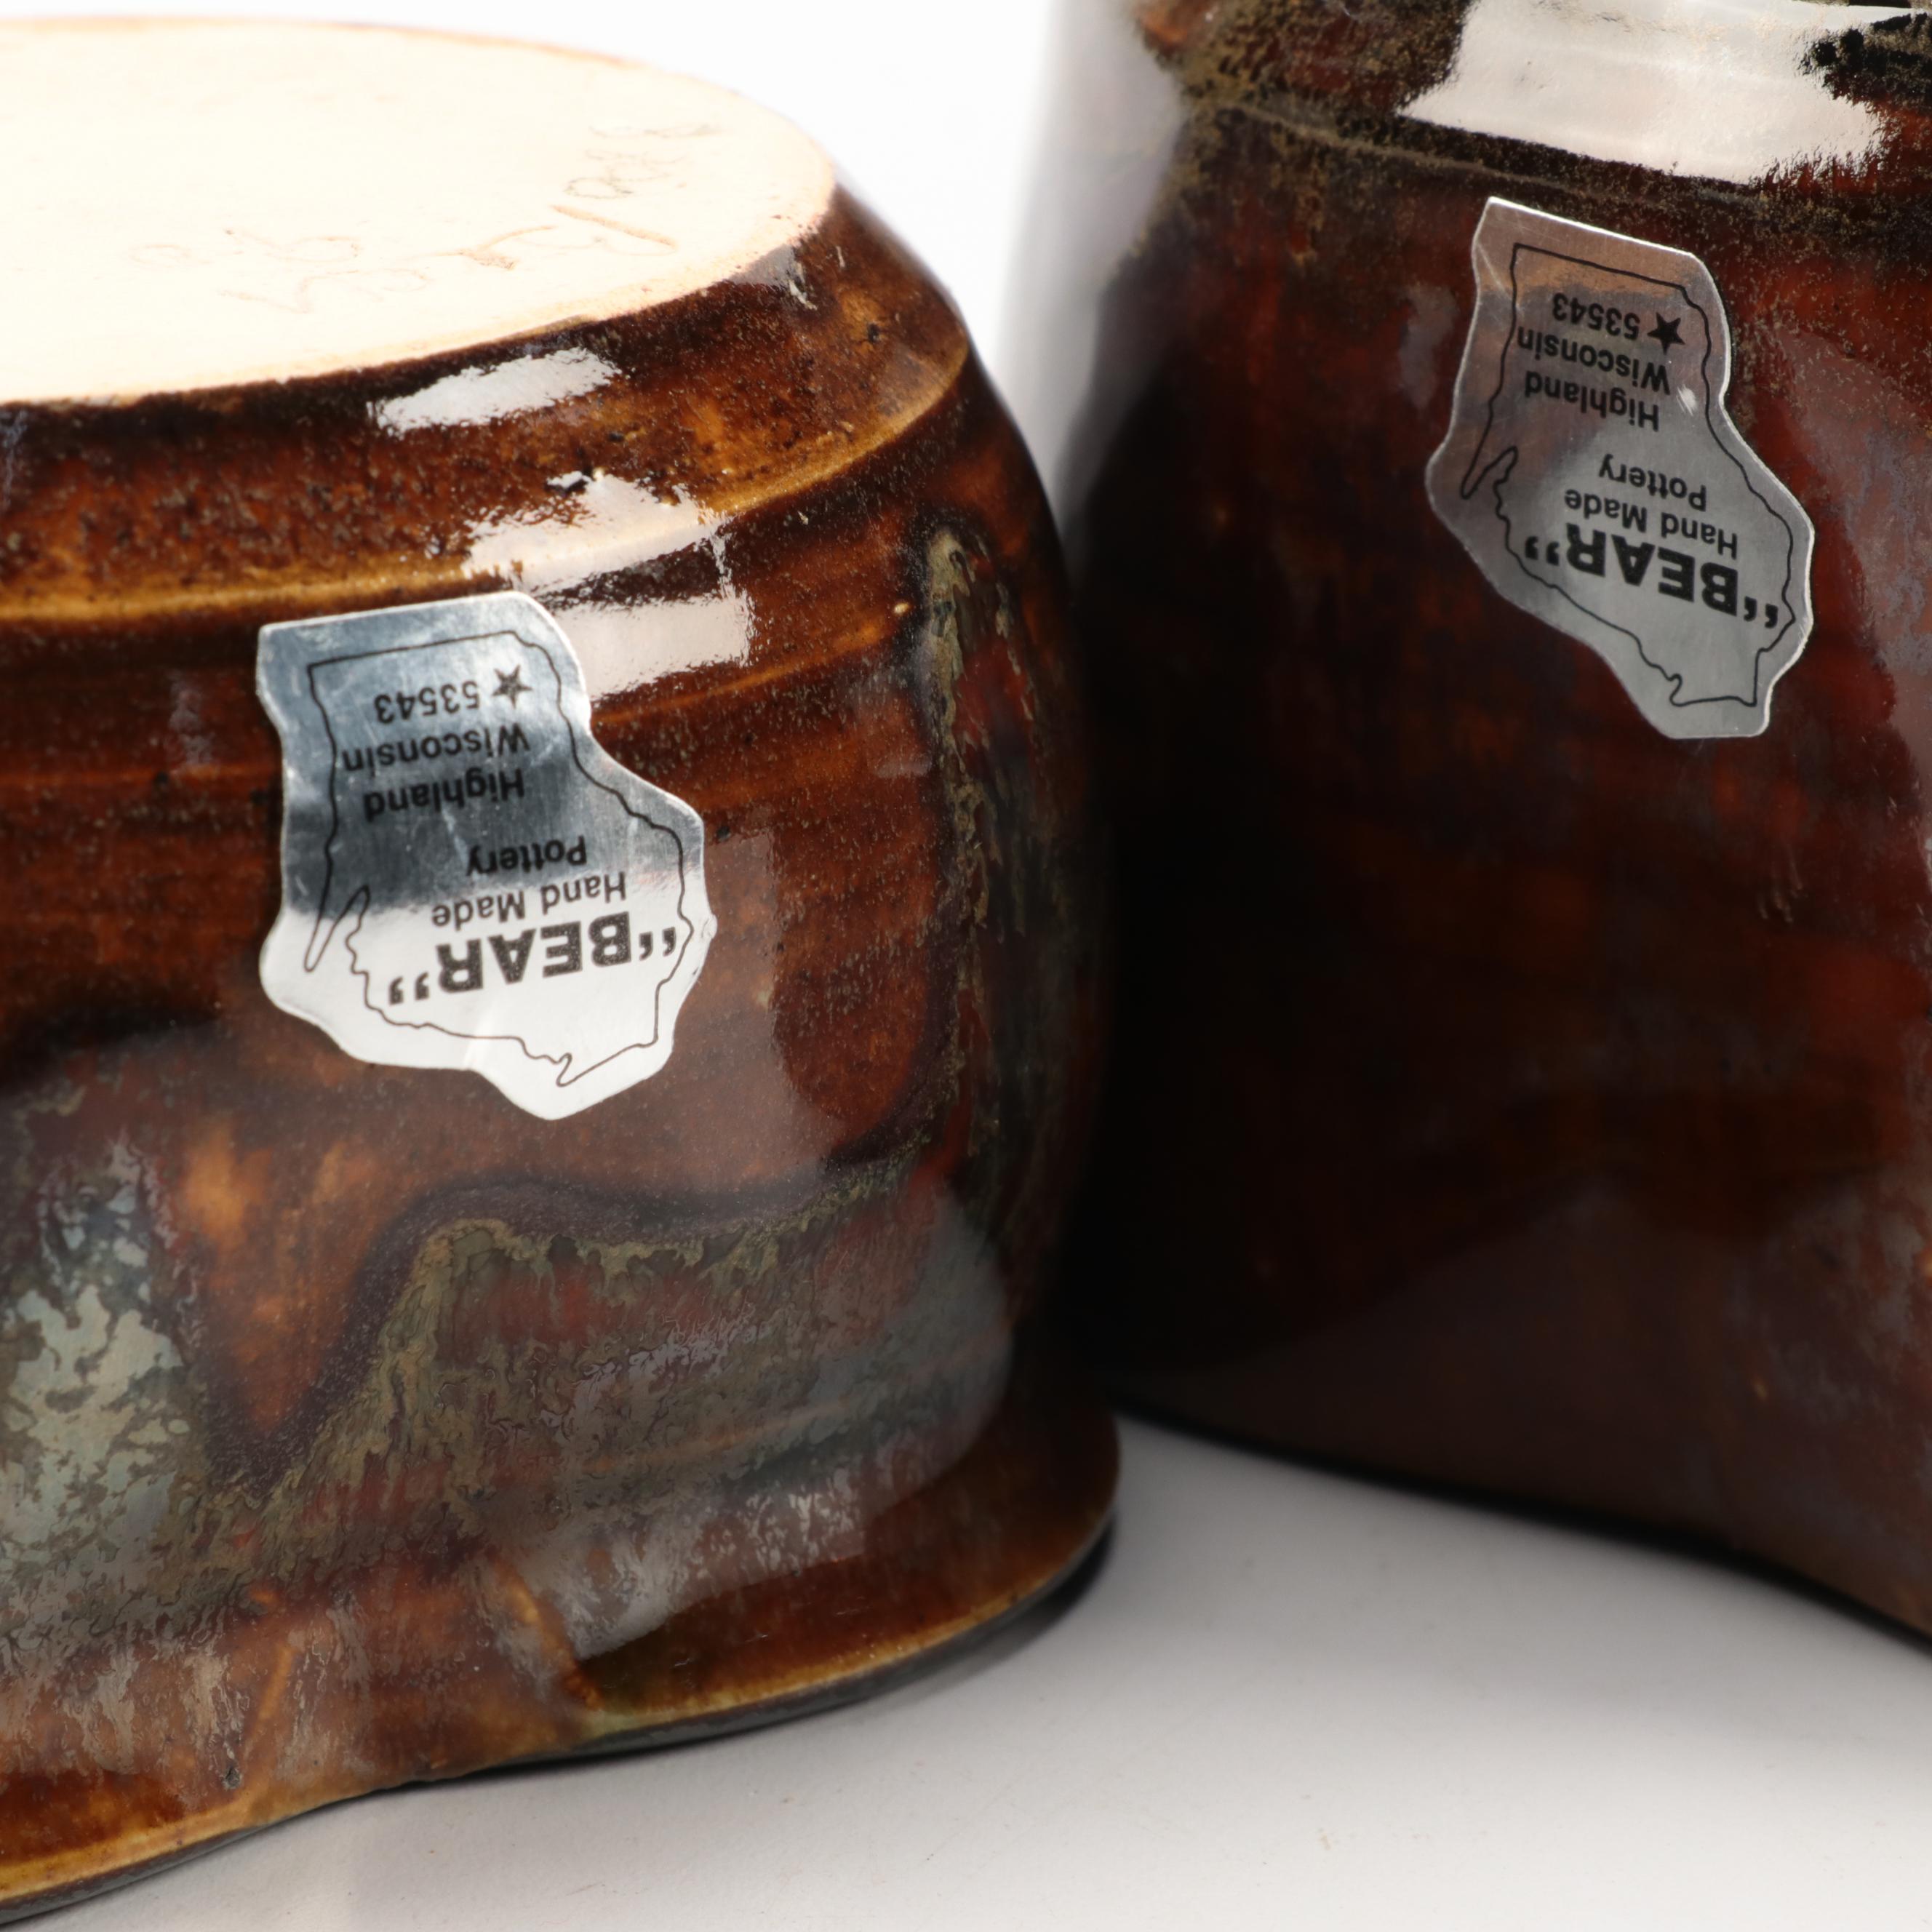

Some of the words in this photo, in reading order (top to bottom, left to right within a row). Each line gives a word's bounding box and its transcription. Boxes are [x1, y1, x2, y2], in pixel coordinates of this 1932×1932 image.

[1553, 293, 1639, 341] 53543
[1517, 327, 1670, 395] Wisconsin
[1526, 372, 1658, 431] Highland
[1599, 454, 1706, 511] Pottery
[1565, 489, 1647, 532] Made
[1661, 513, 1738, 559] Hand
[375, 681, 481, 724] 53543
[342, 724, 530, 775] Wisconsin
[364, 770, 524, 822] Highland
[466, 837, 587, 876] Pottery
[431, 891, 524, 931] Made
[542, 873, 626, 914] Hand
